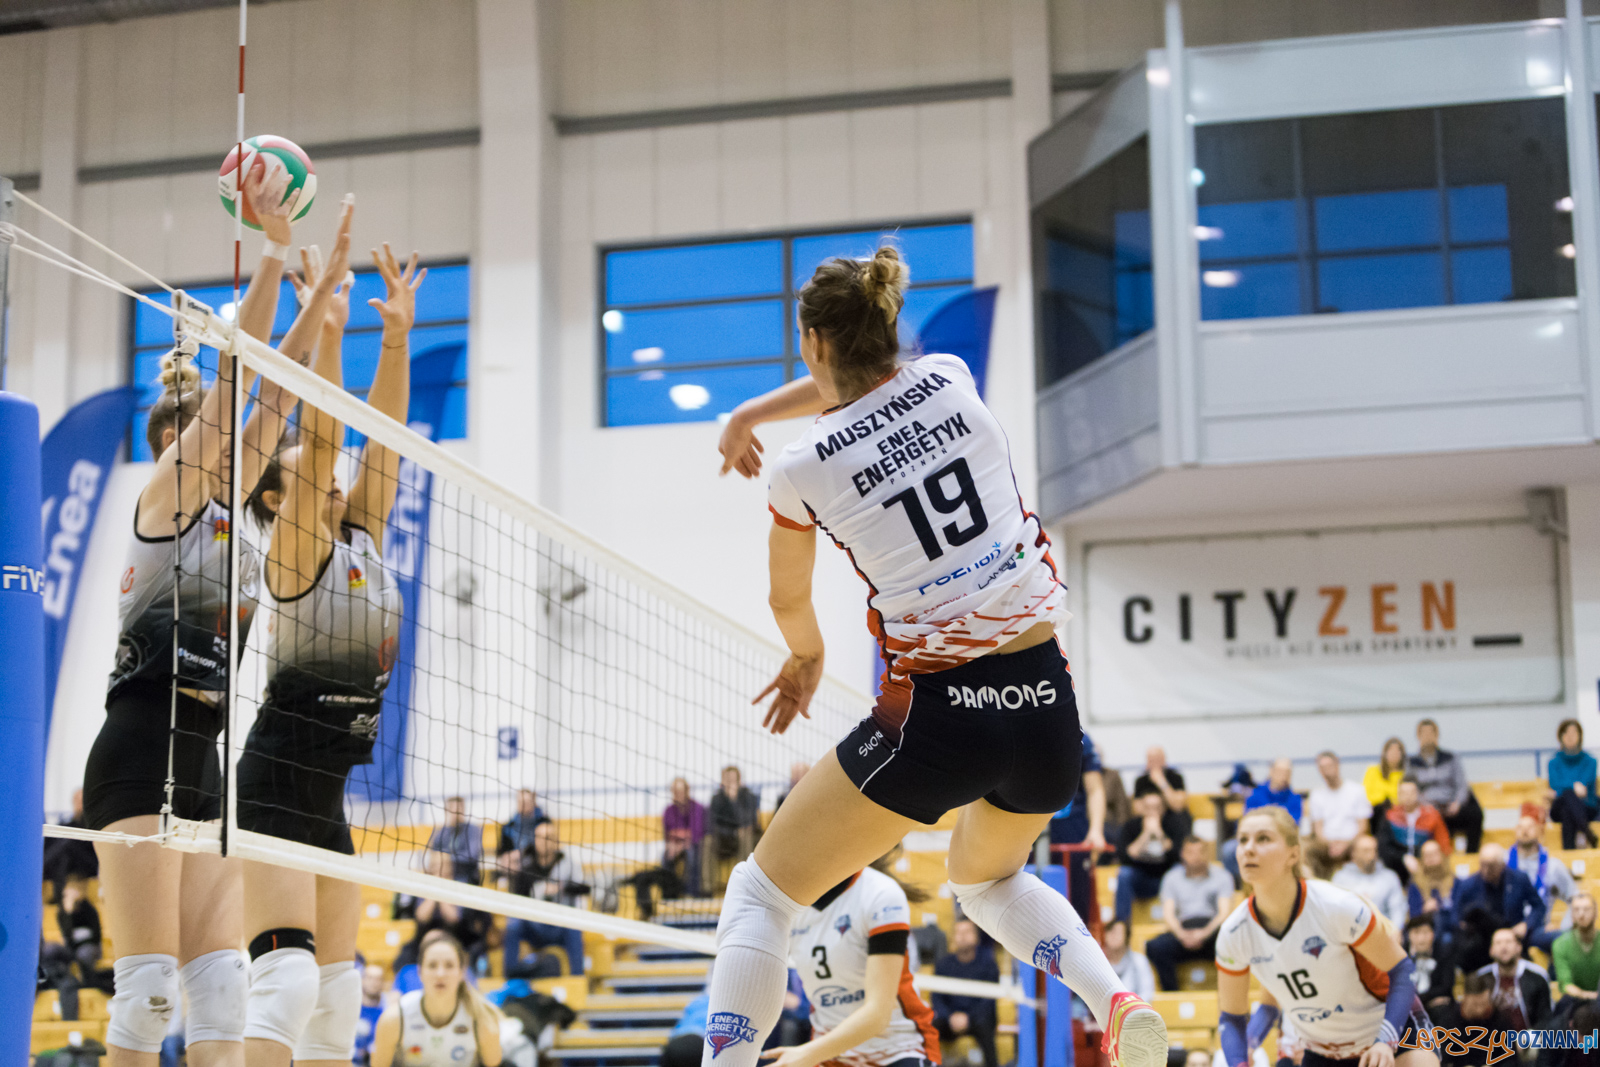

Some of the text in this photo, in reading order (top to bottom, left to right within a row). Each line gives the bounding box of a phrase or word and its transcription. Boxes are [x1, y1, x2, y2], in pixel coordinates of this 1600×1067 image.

[815, 372, 953, 462] MUSZYŃSKA
[876, 420, 928, 457] ENEA
[851, 412, 972, 498] ENERGETYK
[43, 459, 101, 620] Enea
[881, 457, 989, 562] 19
[1123, 580, 1457, 645] CITYZEN
[811, 946, 832, 979] 3
[1277, 969, 1318, 1000] 16
